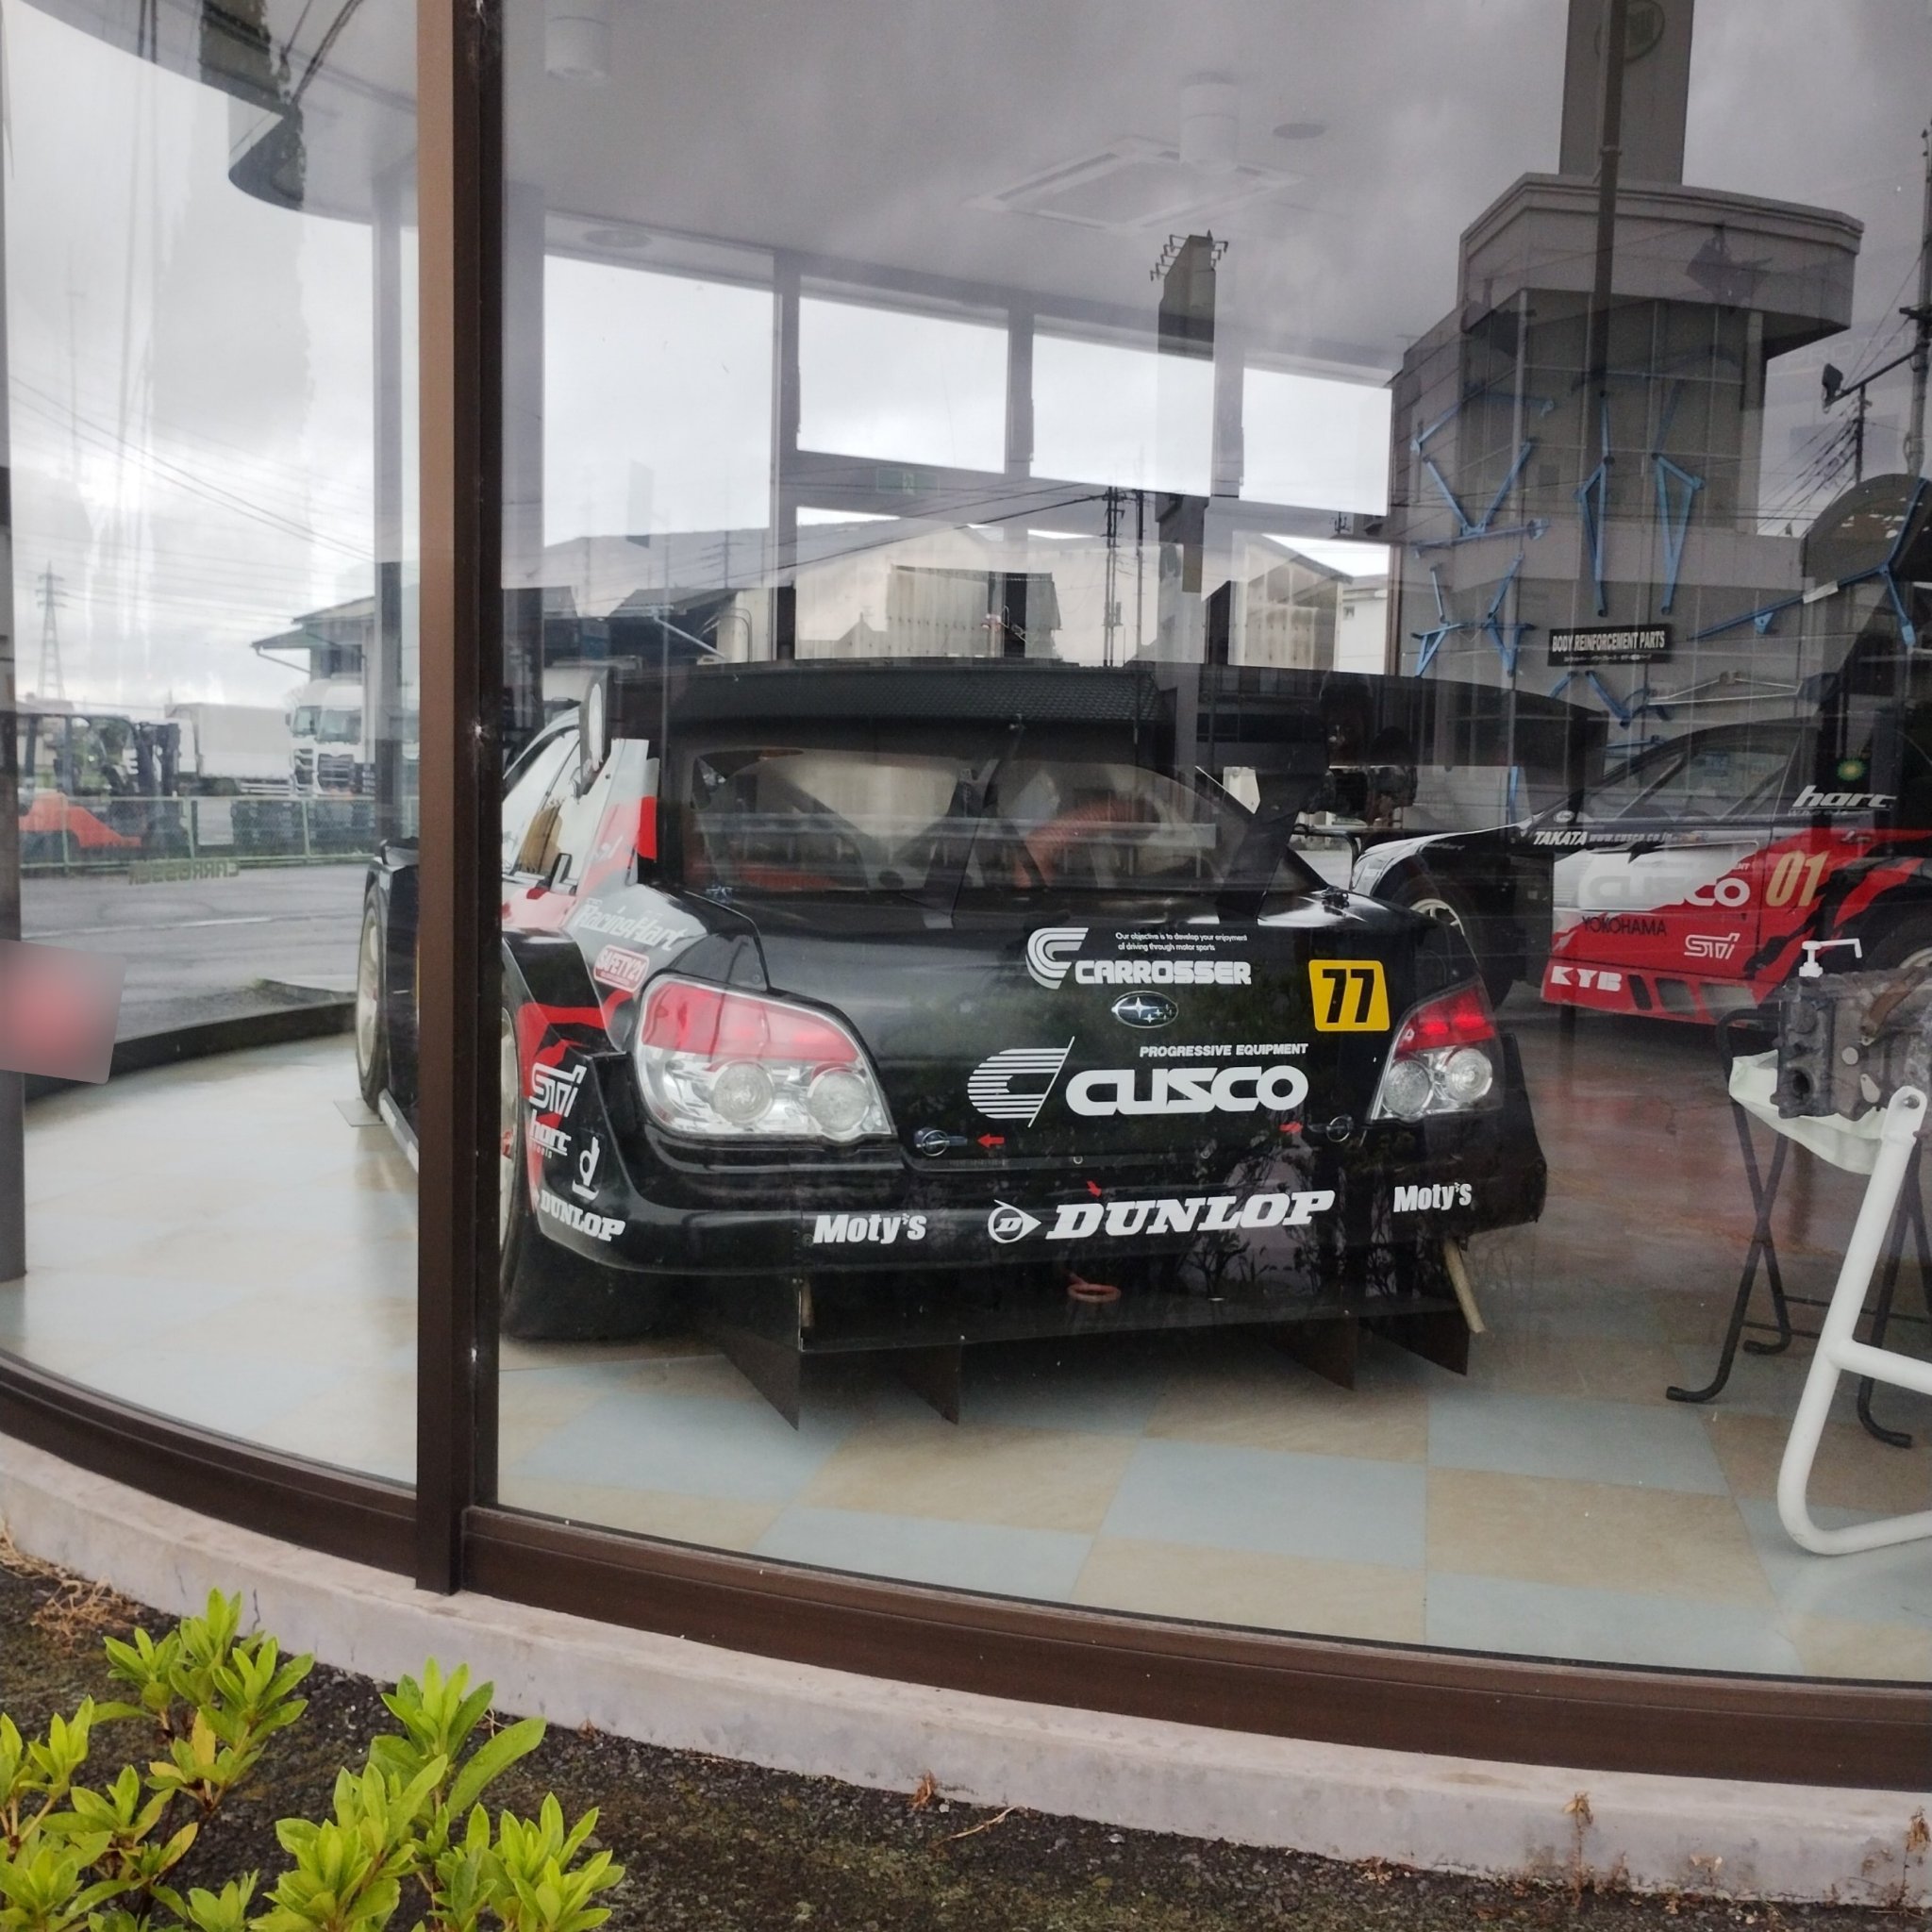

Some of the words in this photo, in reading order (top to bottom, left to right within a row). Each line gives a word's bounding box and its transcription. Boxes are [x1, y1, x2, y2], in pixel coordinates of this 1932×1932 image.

[1552, 635, 1574, 652] BODY
[1574, 631, 1638, 651] REINFORCEMENT
[1640, 630, 1665, 649] PARTS
[1533, 831, 1588, 845] TAKATA
[1765, 850, 1829, 907] 01
[1115, 932, 1129, 941] Our
[1131, 932, 1158, 941] objective
[1174, 933, 1198, 942] develop
[1215, 934, 1247, 942] enjoyment
[1582, 916, 1667, 936] YOKOHAMA
[1118, 942, 1125, 951] of
[1125, 942, 1148, 952] driving
[1149, 942, 1174, 953] through
[1074, 960, 1252, 985] CARROSSER
[1550, 966, 1623, 991] KYB
[1323, 969, 1374, 1024] 77
[1140, 1045, 1232, 1058] PROGRESSIVE
[1236, 1043, 1308, 1056] EQUIPMENT
[1066, 1065, 1308, 1116] CUSCO
[1393, 1182, 1472, 1212] Moty's
[541, 1190, 625, 1241] DUNLOP
[1044, 1190, 1336, 1240] DUNLOP
[813, 1213, 926, 1244] Moty's
